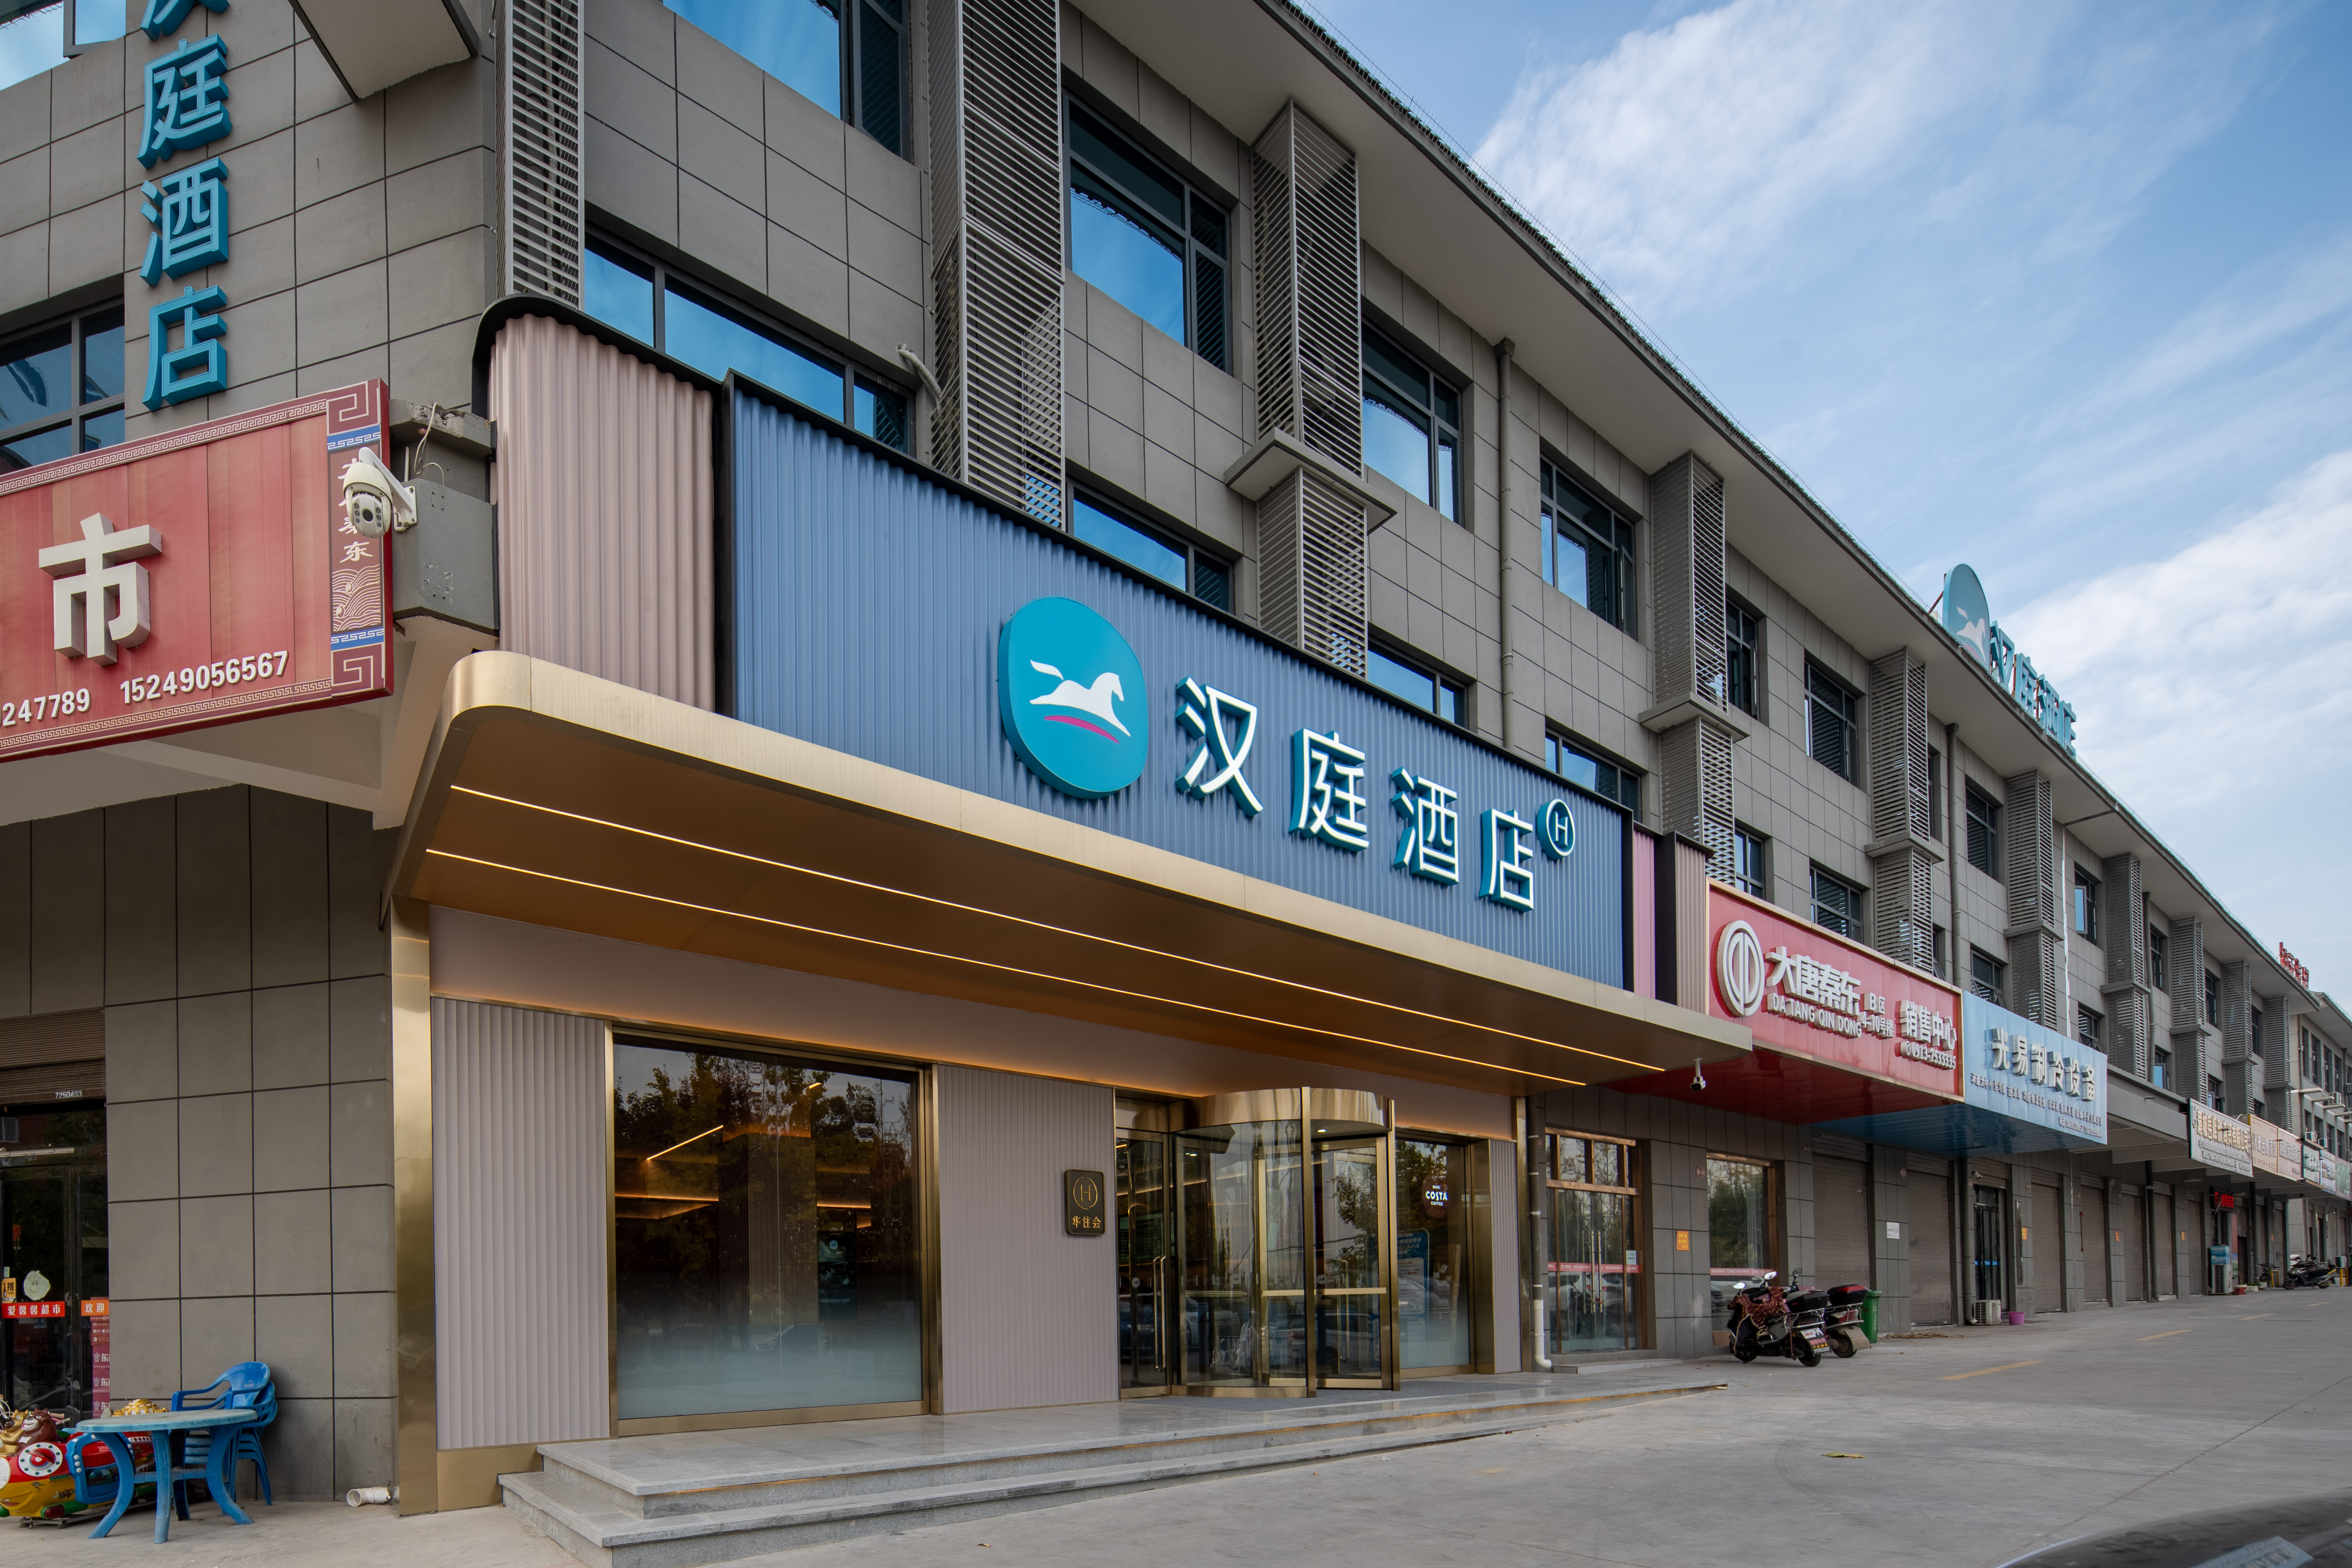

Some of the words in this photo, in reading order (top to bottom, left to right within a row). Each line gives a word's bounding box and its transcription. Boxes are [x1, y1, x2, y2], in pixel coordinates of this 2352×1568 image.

[38, 512, 163, 666] 市
[0, 688, 91, 727] 247789
[120, 650, 289, 704] 15249056567
[1175, 676, 1534, 913] 汉庭酒店
[1765, 945, 1861, 1016] 大唐秦东
[1900, 999, 1957, 1051] 销售中心
[1768, 992, 1786, 1013] DA
[1786, 998, 1815, 1023] TANG
[1817, 1009, 1835, 1029] QIN
[1835, 1015, 1862, 1038] DONG
[1857, 1011, 1894, 1038] 4-10号楼
[1991, 1027, 2095, 1102] 光易制冷设备
[55, 1090, 82, 1099] 7250493
[1425, 1190, 1449, 1201] COSTA
[1072, 1215, 1101, 1229] 华住会
[7, 1281, 15, 1291] 推
[7, 1304, 61, 1316] 爱馨馨超市
[85, 1303, 110, 1313] 欢迎
[101, 1353, 110, 1362] 东
[101, 1378, 110, 1387] 东
